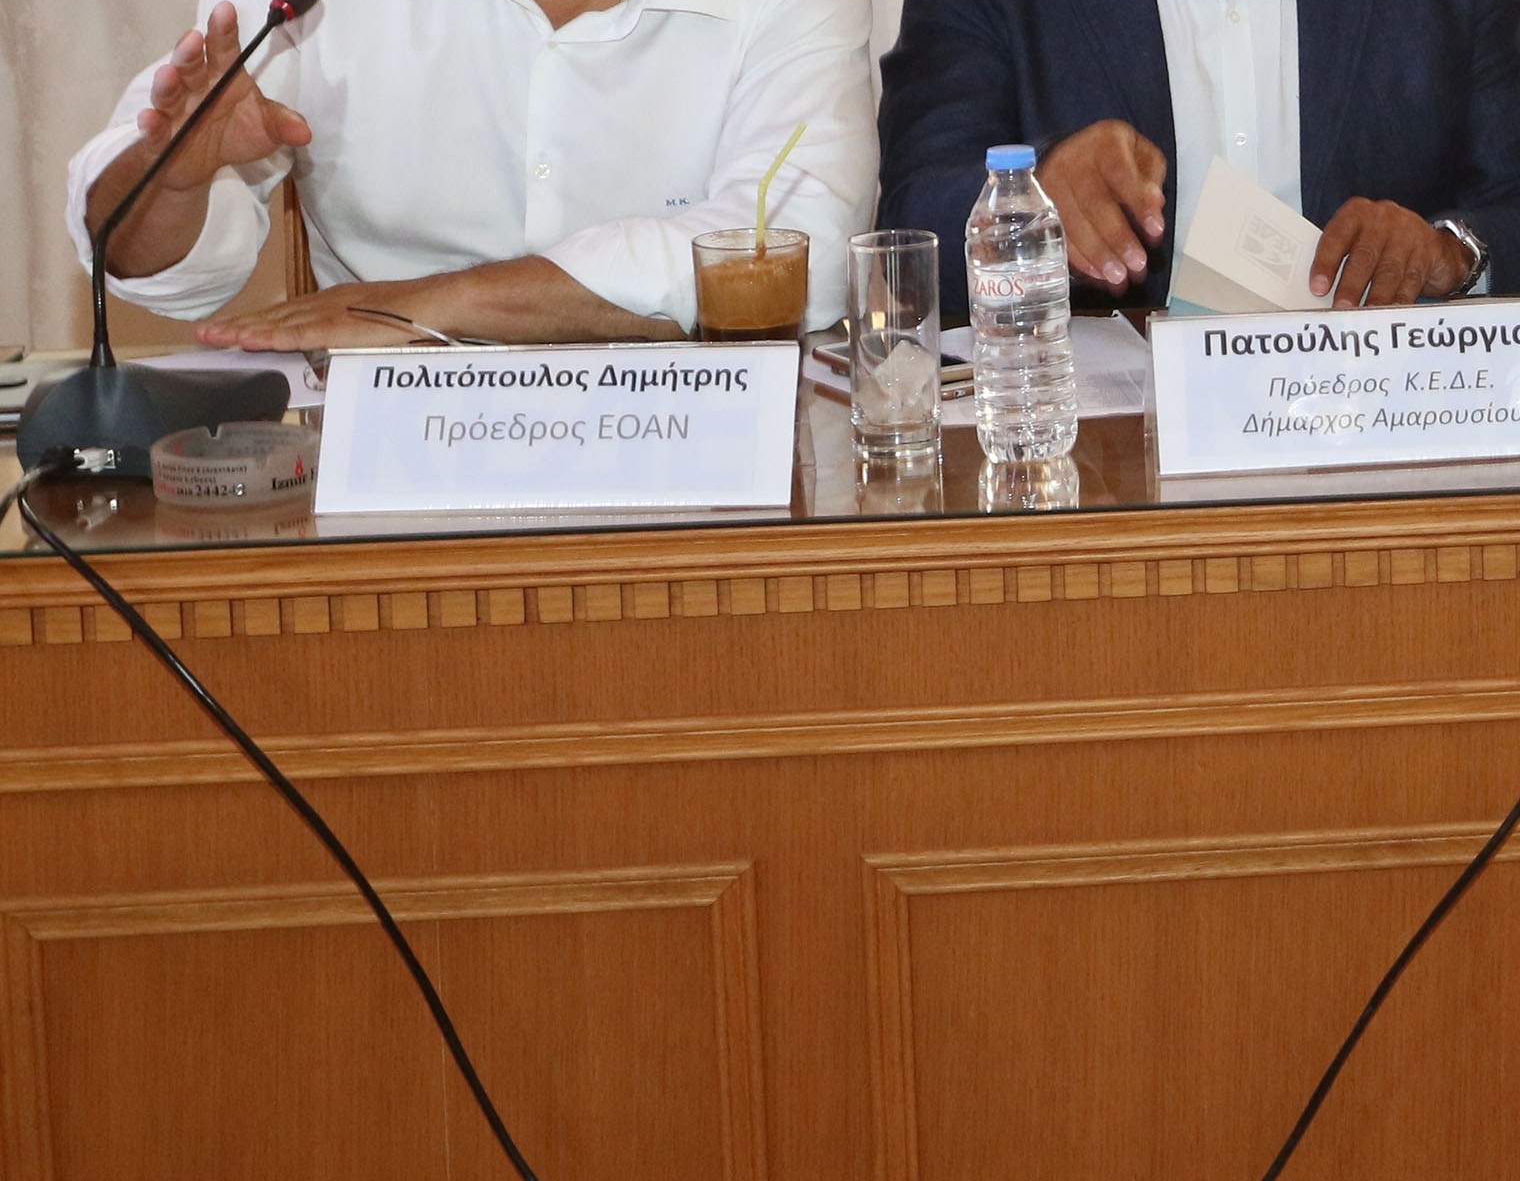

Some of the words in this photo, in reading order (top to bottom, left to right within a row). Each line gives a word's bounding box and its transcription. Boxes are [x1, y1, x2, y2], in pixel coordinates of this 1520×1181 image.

[1204, 323, 1380, 358] Πατούλης
[373, 363, 590, 393] Πολιτόπουλος
[597, 361, 749, 393] Δημήτρης
[1268, 373, 1391, 402] Πρόεδρος
[1404, 369, 1494, 392] Κ.Ε.Δ.Ε.
[423, 412, 587, 448] Πρόεδρος
[598, 413, 689, 440] ΕΟΑΝ
[1241, 410, 1366, 438] Δήμαρχος
